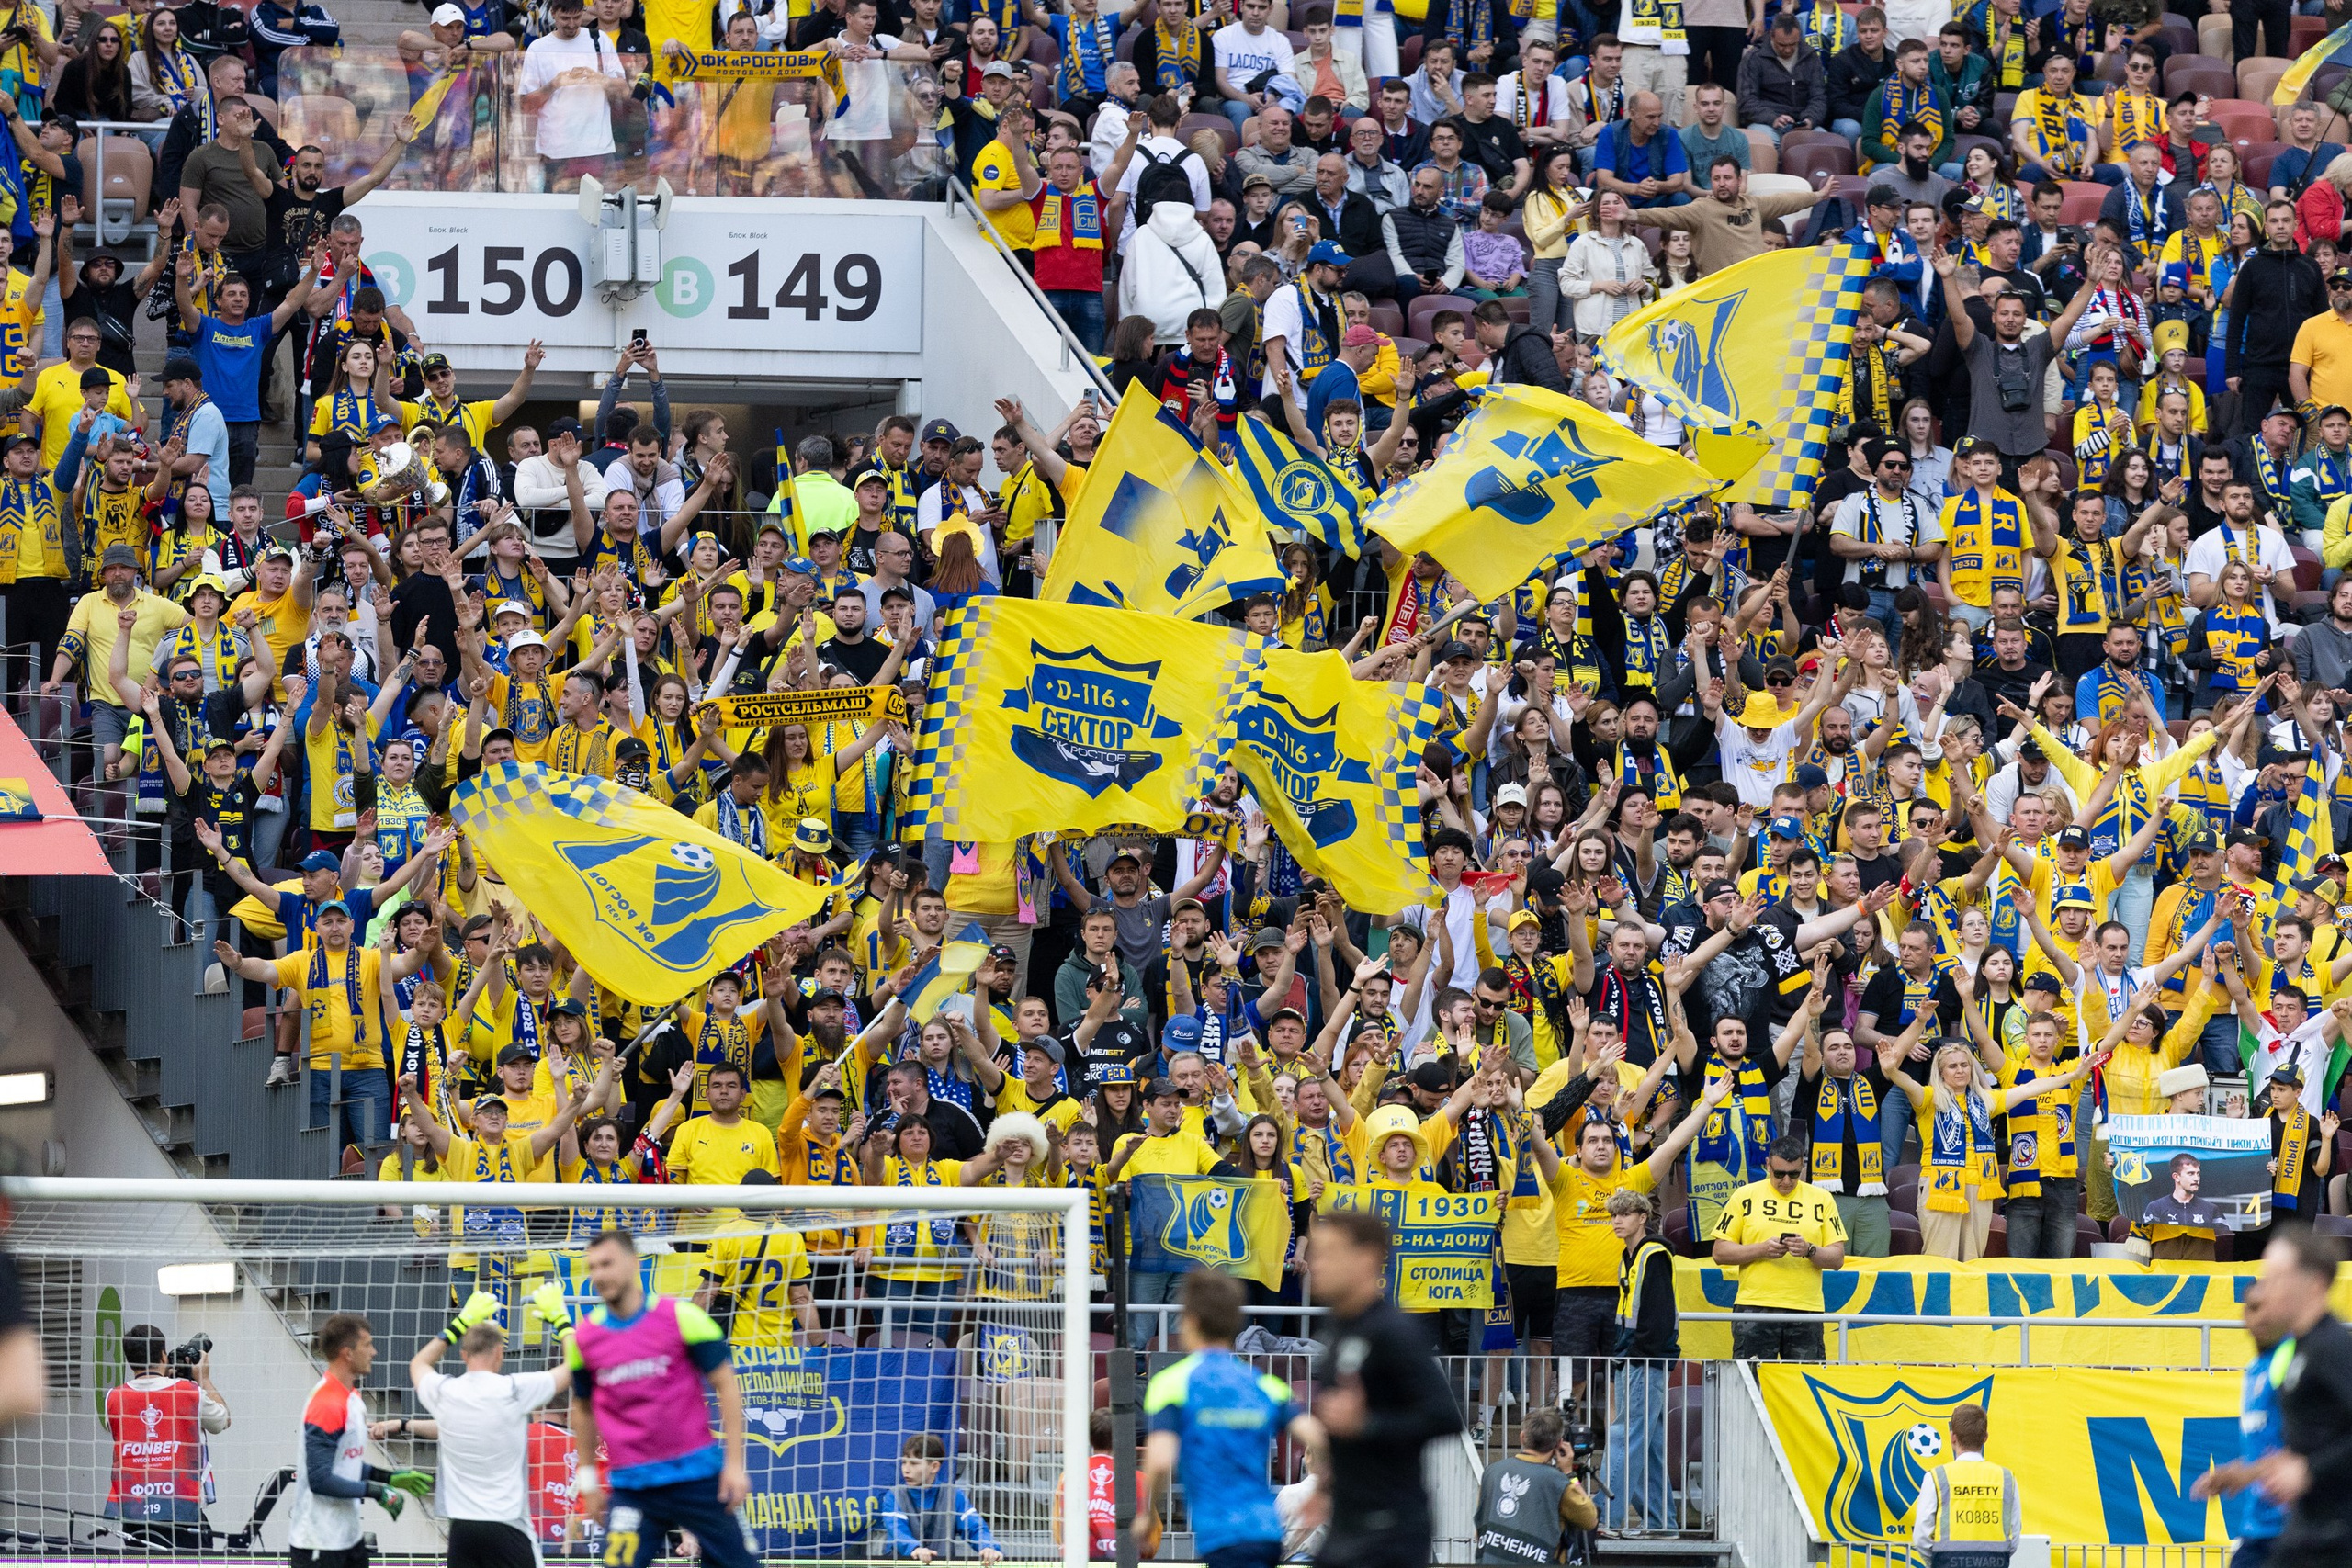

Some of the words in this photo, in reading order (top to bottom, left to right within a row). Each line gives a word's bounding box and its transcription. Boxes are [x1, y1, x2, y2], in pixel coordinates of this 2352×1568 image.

[701, 54, 727, 67] ФК
[427, 243, 583, 317] 150
[673, 270, 699, 305] B
[728, 248, 882, 322] 149
[1307, 355, 1329, 366] 1930
[6, 415, 20, 423] 193
[1953, 559, 1978, 570] 1930
[759, 691, 822, 702] ГАНДБОЛЬНЫЙ
[1057, 680, 1115, 708] D-116
[739, 696, 866, 718] РОСТСЕЛЬМАШ
[768, 713, 839, 725] РОСТОВ-НА-ДОНУ
[1041, 707, 1133, 749] СЕКТОР
[1263, 716, 1308, 764] D-116
[1070, 746, 1126, 762] РОСТОВ
[1107, 1068, 1126, 1079] FCR
[2109, 1134, 2149, 1145] КОТОРУЮ
[2153, 1135, 2170, 1145] МЯЧ
[2226, 1134, 2270, 1150] НИКОГДА!
[2283, 1140, 2300, 1179] ЮНЫЙ
[1418, 1197, 1488, 1217] 1930
[1392, 1233, 1491, 1247] В-НА-ДОНУ
[1204, 1245, 1229, 1258] РОСТОВ
[1410, 1267, 1485, 1282] СТОЛИЦА
[1429, 1286, 1464, 1300] ЮГА
[741, 1395, 807, 1407] ОСТОВ-НА-ДОНУ
[122, 1440, 182, 1456] FONBET
[130, 1482, 175, 1496] ФОТО
[1954, 1486, 1999, 1495] SAFETY
[143, 1504, 161, 1515] 219
[745, 1493, 819, 1534] МАНДА
[822, 1496, 862, 1534] 116
[1956, 1510, 1999, 1525] K0885
[1886, 1525, 1906, 1535] ФК
[1950, 1556, 2005, 1567] STEWARD
